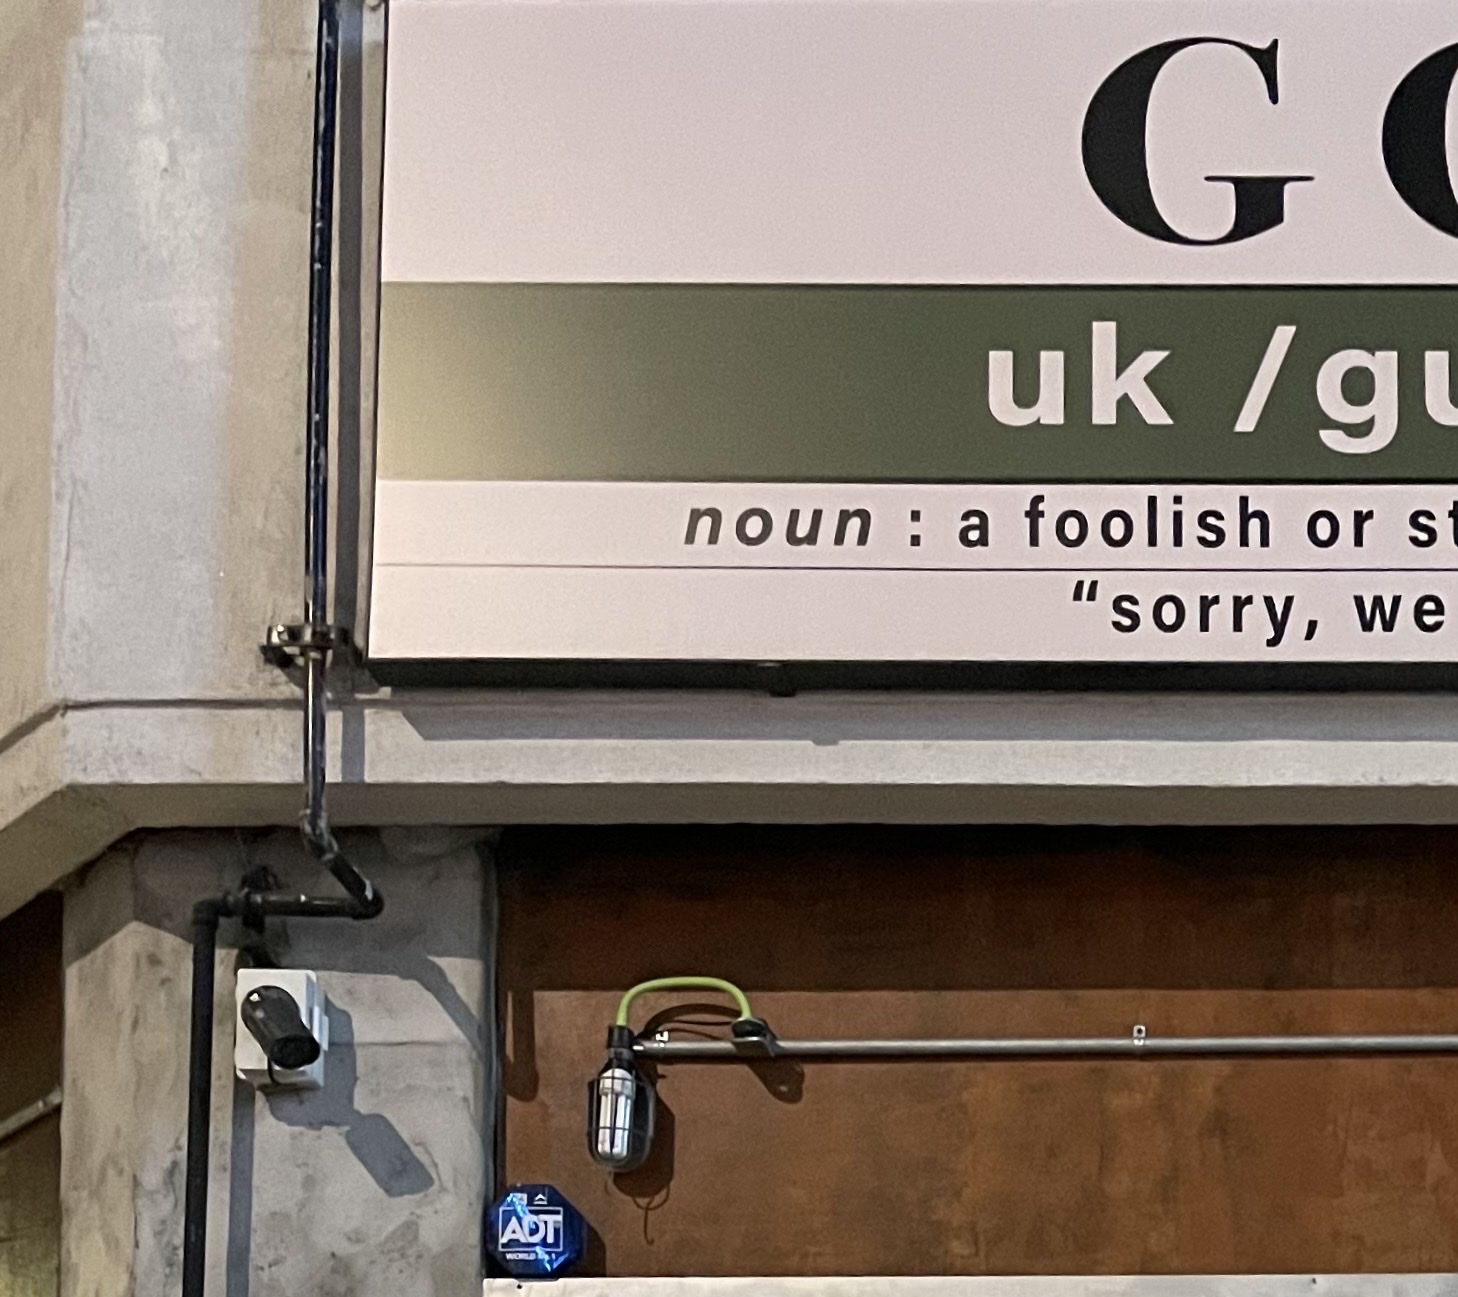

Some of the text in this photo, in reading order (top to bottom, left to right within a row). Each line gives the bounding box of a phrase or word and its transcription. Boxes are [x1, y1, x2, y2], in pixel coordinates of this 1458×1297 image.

[988, 320, 1174, 427] uk
[683, 506, 873, 548] noun
[957, 508, 990, 550] a
[1024, 493, 1271, 550] foolish
[1305, 508, 1375, 550] or
[1352, 593, 1446, 634] we
[500, 1213, 562, 1244] ADT
